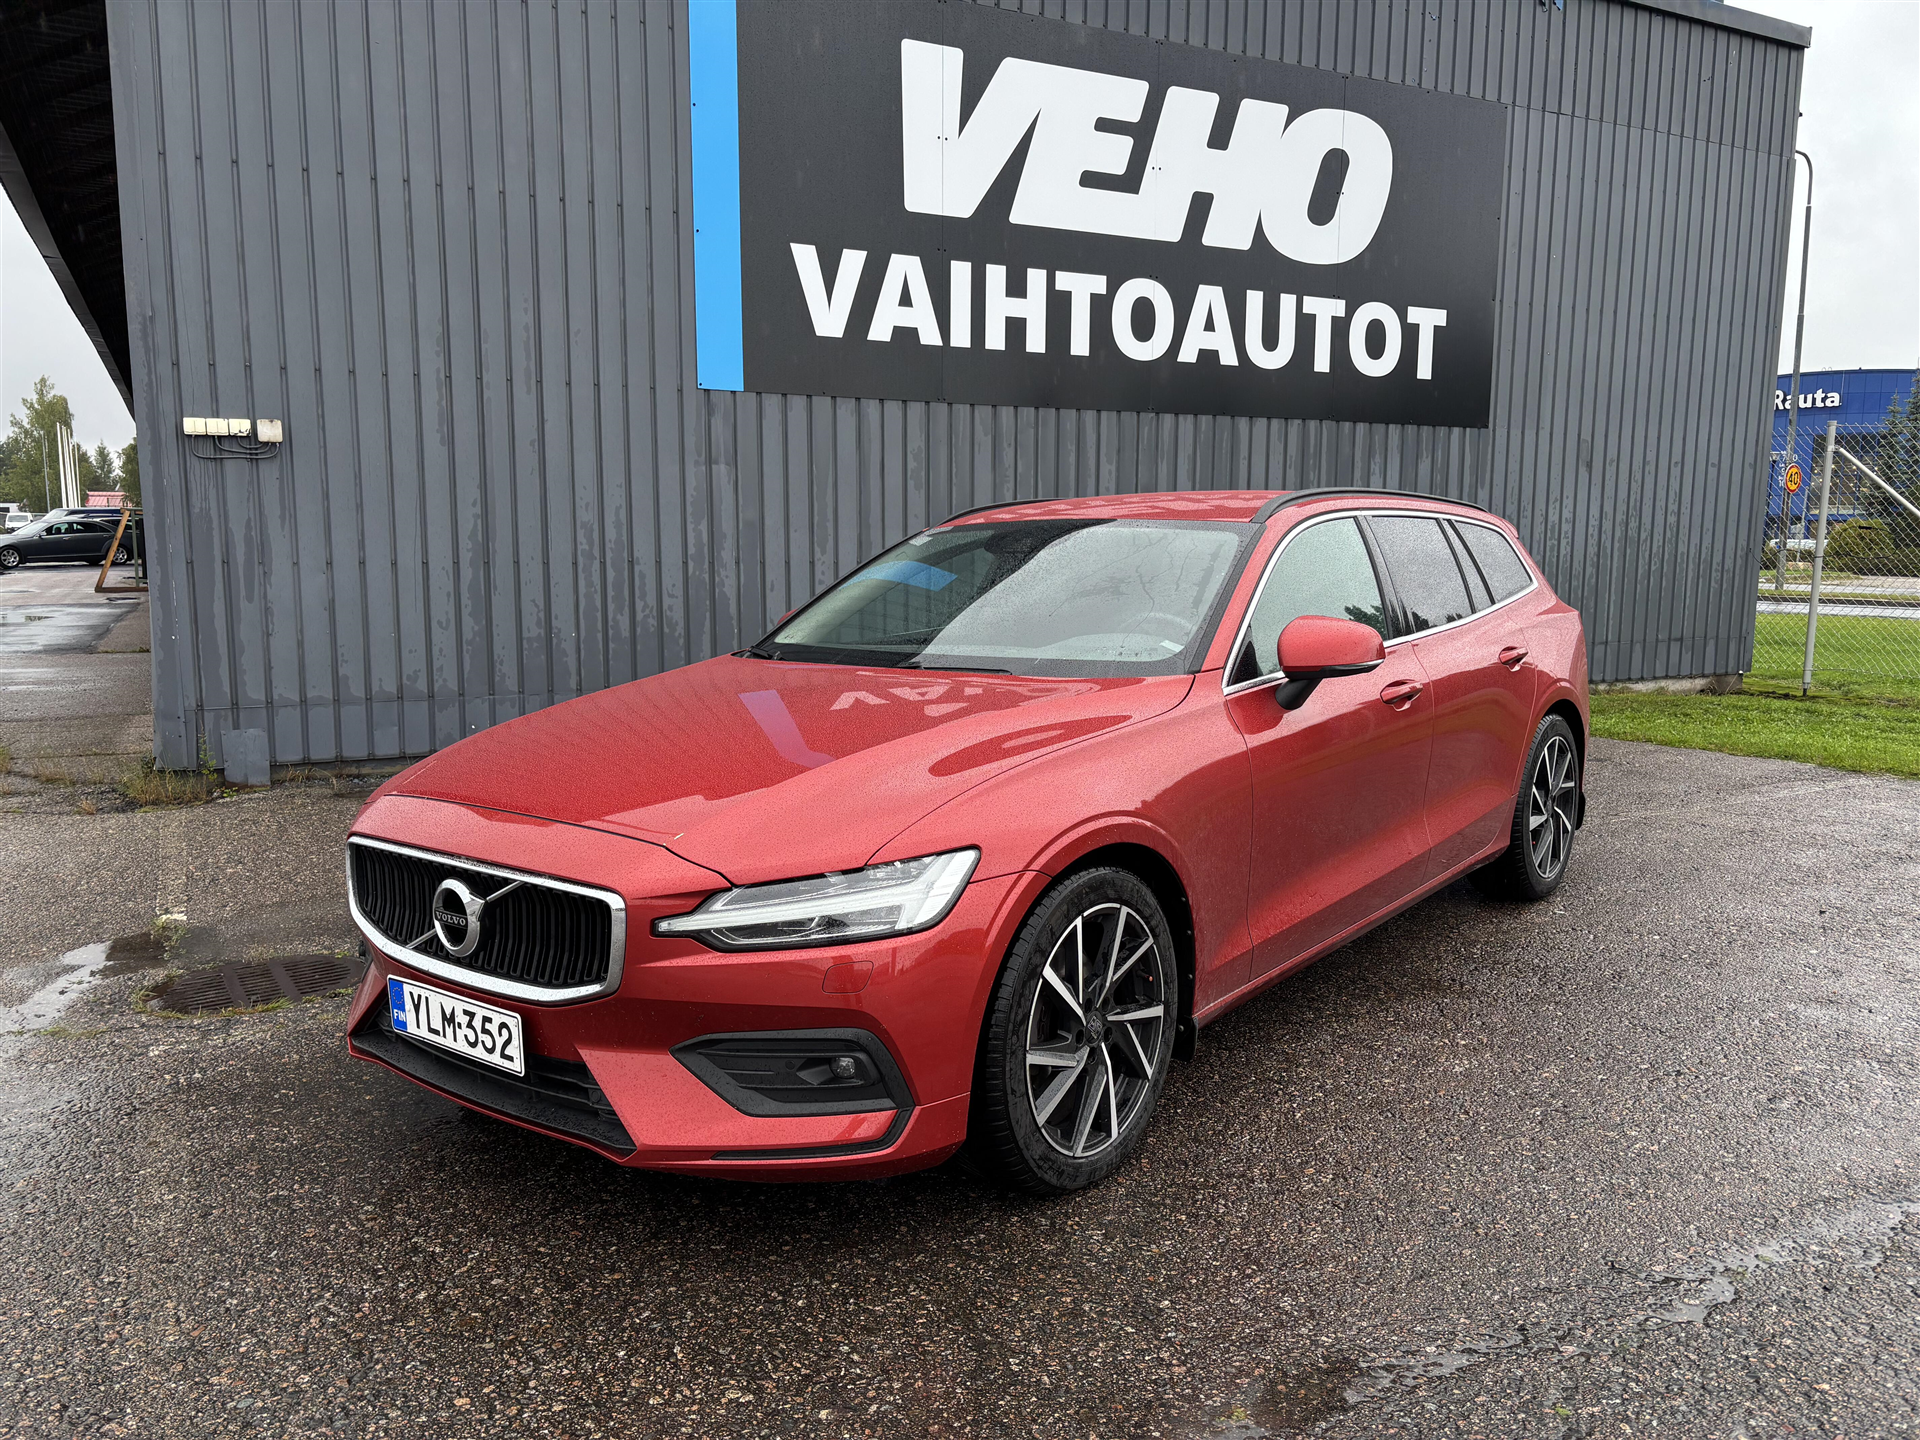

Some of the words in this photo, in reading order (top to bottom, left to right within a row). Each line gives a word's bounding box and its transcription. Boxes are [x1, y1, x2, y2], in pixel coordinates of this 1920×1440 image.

[901, 39, 1392, 264] VEHO
[790, 243, 1447, 380] VAIHTOAUTOT
[1788, 471, 1799, 486] 40
[435, 911, 466, 926] VOLVO
[393, 1009, 406, 1023] FIN
[409, 991, 515, 1063] YLM-352
